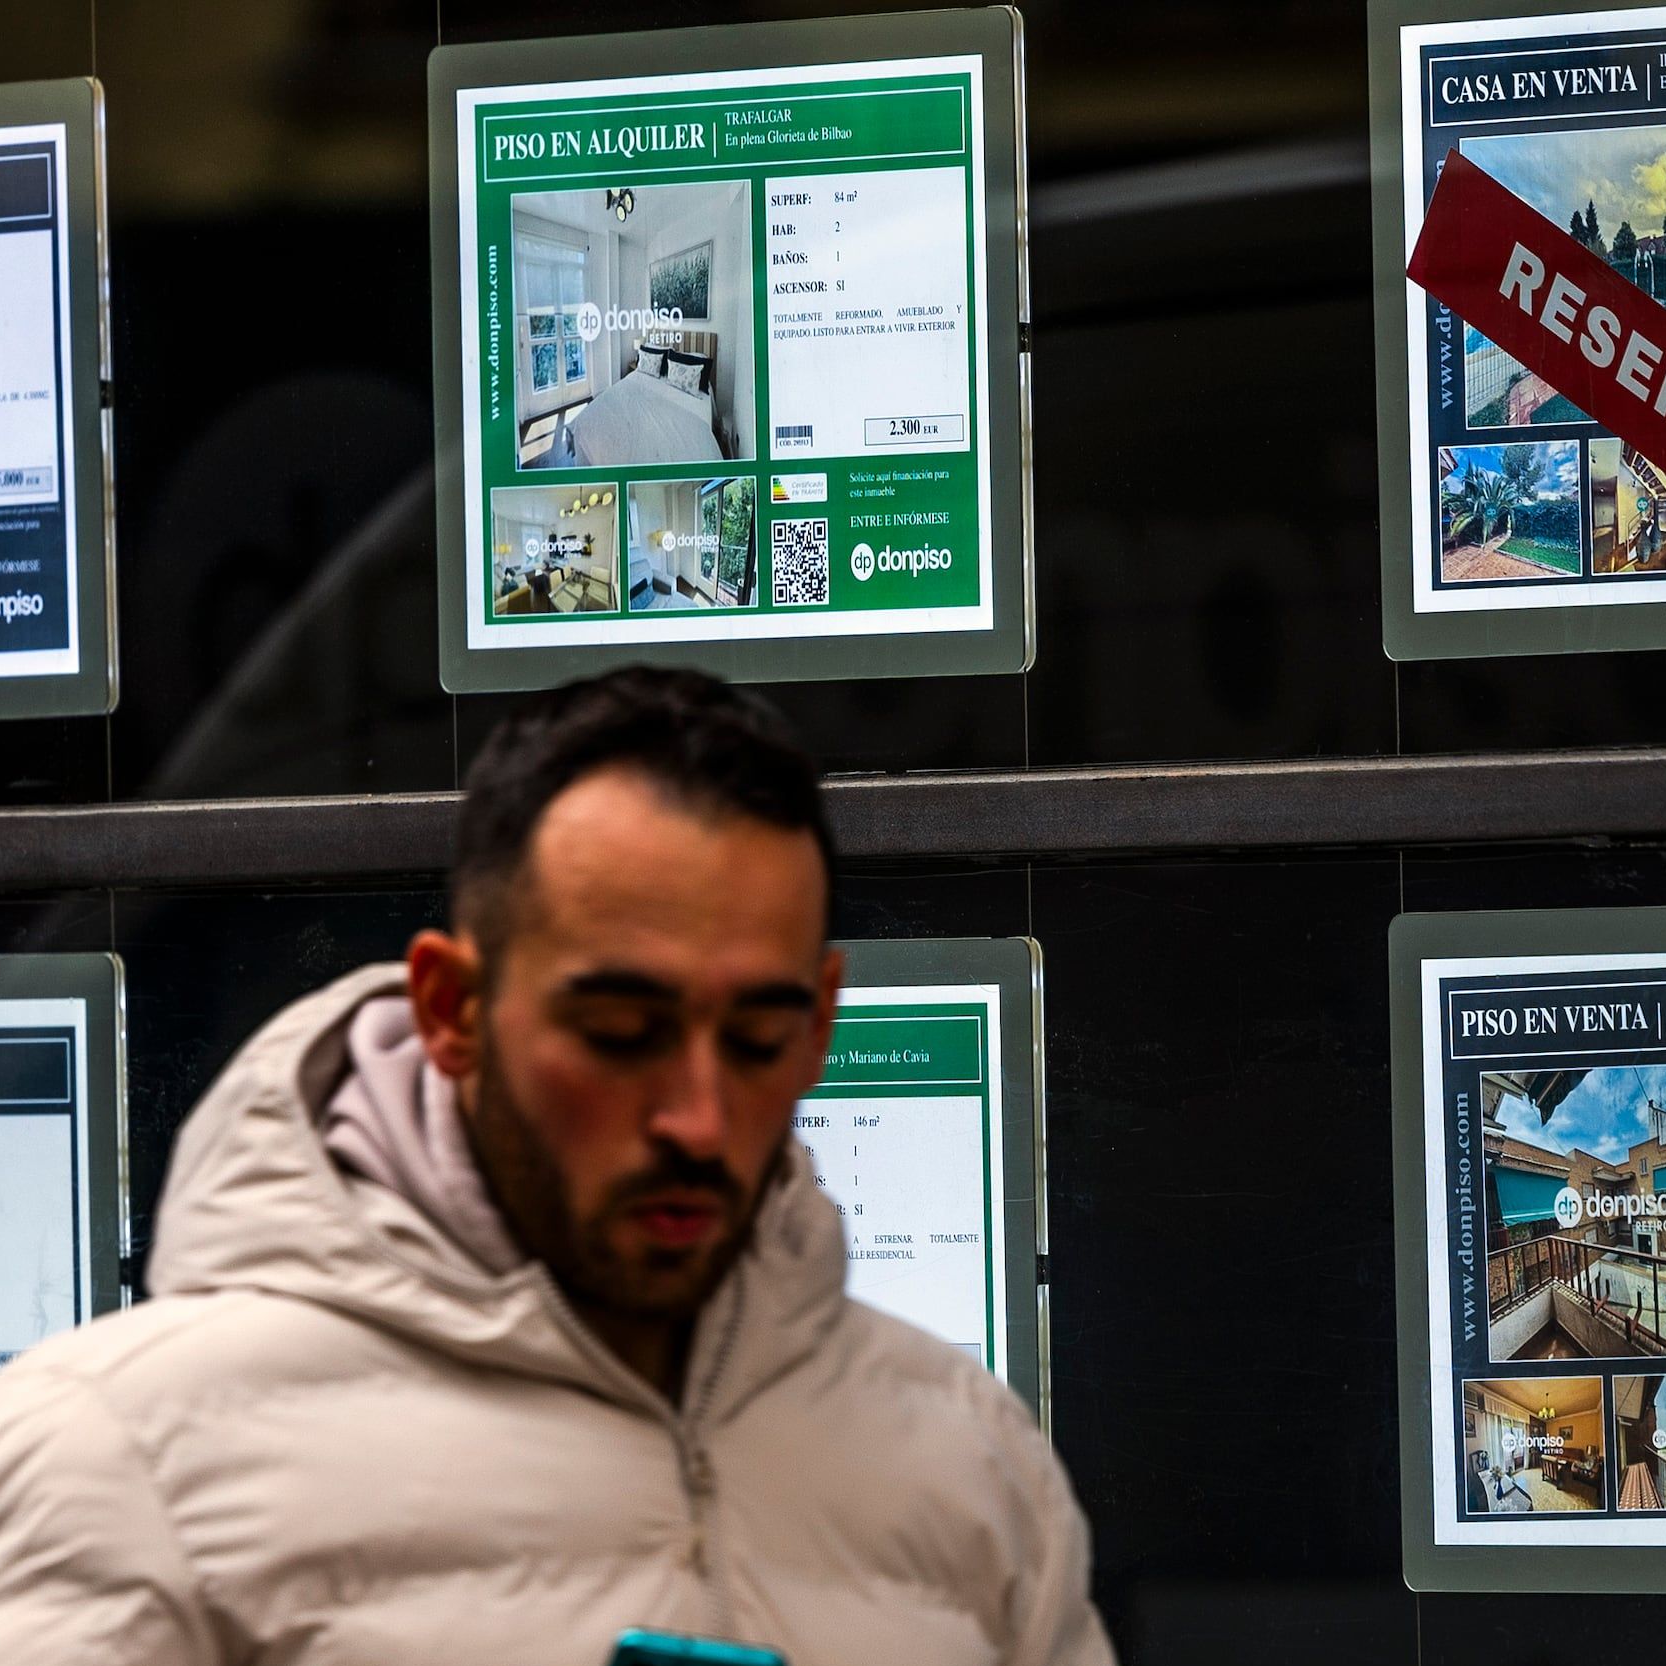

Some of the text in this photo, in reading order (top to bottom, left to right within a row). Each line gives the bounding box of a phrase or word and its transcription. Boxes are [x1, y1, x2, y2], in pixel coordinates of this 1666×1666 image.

[1441, 64, 1638, 105] CASA EN VENTA
[724, 108, 793, 126] TRAFALGAR
[494, 123, 706, 161] PISO EN ALQUILER
[725, 126, 853, 150] En plena Glorieta de Bilbao
[770, 189, 858, 207] SUPERF: 84 m²
[606, 304, 683, 334] donpiso
[773, 305, 944, 324] TOTALMENTE REFORMADO, AMUEBLADO
[487, 243, 501, 422] www.donpiso.com
[649, 331, 683, 345] RETIRO
[889, 419, 939, 436] 2.300 EUR
[877, 542, 952, 578] donpiso
[1460, 1003, 1649, 1037] PISO EN VENTA
[848, 1048, 930, 1064] Mariano de Cavia
[853, 1115, 880, 1127] 146 m²
[1455, 1090, 1479, 1343] www.donpiso.com
